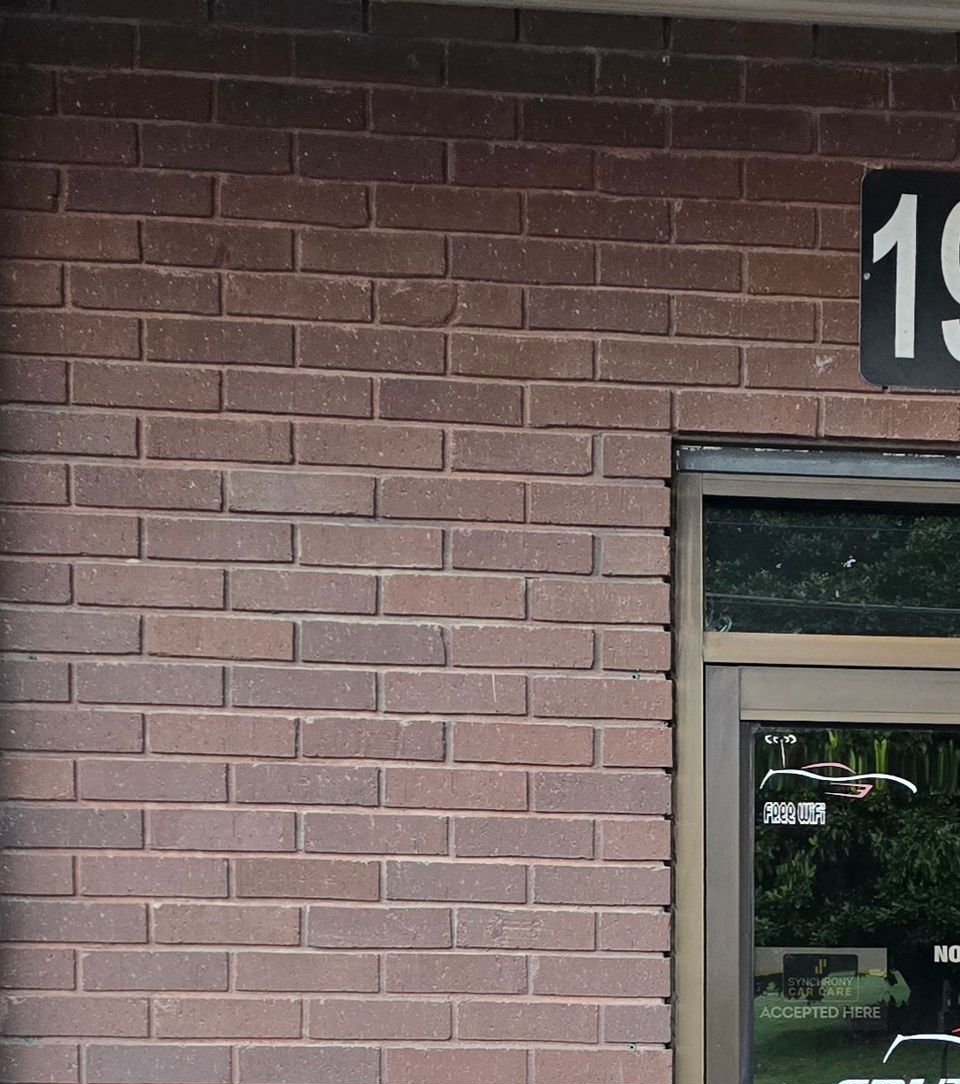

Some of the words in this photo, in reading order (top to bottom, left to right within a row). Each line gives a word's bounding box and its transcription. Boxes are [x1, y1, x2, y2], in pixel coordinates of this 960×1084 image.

[787, 976, 854, 988] SYNCHRONY
[788, 986, 814, 997] CAR
[818, 986, 853, 997] CARE
[760, 1006, 839, 1019] ACCEPTED
[843, 1006, 881, 1019] HERE
